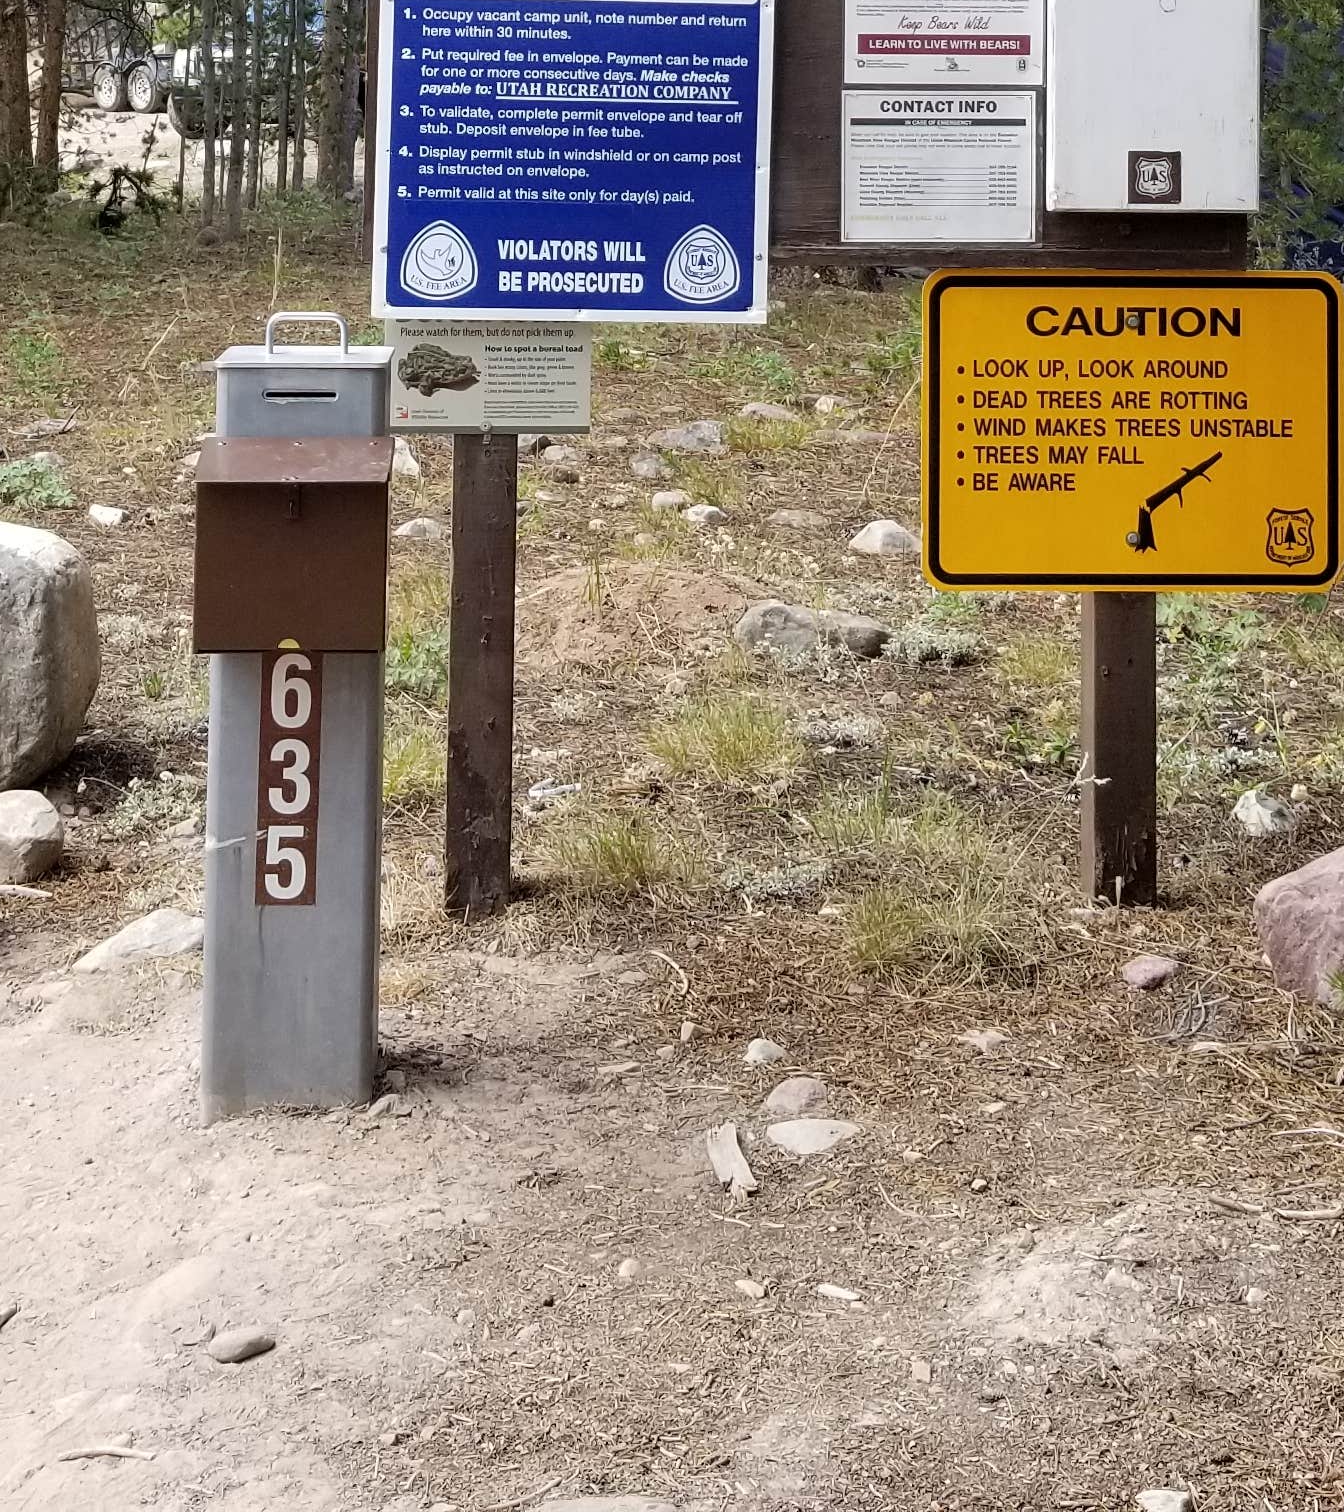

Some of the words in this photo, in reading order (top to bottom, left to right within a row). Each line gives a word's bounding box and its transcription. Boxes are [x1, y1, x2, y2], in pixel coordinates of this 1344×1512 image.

[404, 7, 417, 20] 1.
[423, 7, 473, 24] Occupy
[476, 9, 521, 22] vacant
[523, 12, 561, 26] camp
[564, 10, 590, 25] unit,
[595, 12, 625, 24] note
[628, 11, 677, 26] number
[680, 13, 706, 26] and
[708, 14, 747, 27] return
[897, 15, 922, 35] Keep
[927, 16, 958, 30] Bears
[964, 16, 991, 30] Wild
[422, 24, 451, 37] here
[454, 25, 494, 38] within
[497, 26, 513, 39] 30
[516, 26, 571, 40] minutes.
[869, 39, 907, 49] LEARN
[907, 40, 921, 49] TO
[924, 40, 947, 49] LIVE
[949, 40, 976, 49] WITH
[980, 40, 1020, 50] BEARS!
[401, 47, 416, 60] 2.
[422, 47, 444, 60] Put
[447, 48, 501, 64] required
[504, 49, 524, 62] fee
[527, 50, 539, 62] in
[542, 51, 603, 67] envelope.
[607, 52, 662, 67] Payment
[665, 54, 689, 65] can
[692, 53, 709, 66] be
[712, 54, 748, 67] made
[420, 65, 439, 78] for
[441, 68, 467, 78] one
[470, 69, 484, 79] or
[487, 69, 521, 80] more
[523, 68, 600, 81] consecutive
[603, 68, 636, 83] days.
[640, 69, 677, 82] Make
[681, 70, 730, 83] checks
[419, 82, 471, 97] payable
[475, 83, 492, 95] to:
[496, 81, 540, 97] UTAH
[546, 83, 649, 98] RECREATION
[653, 85, 732, 100] COMPANY
[400, 105, 414, 117] 3.
[420, 105, 436, 118] To
[439, 105, 494, 120] validate,
[497, 107, 559, 122] complete
[562, 108, 604, 123] permit
[607, 110, 666, 124] envelope
[669, 110, 693, 122] and
[696, 111, 723, 123] tear
[725, 111, 742, 123] off
[879, 100, 954, 113] CONTACT
[958, 100, 997, 113] INFO
[497, 239, 598, 261] VIOLATORS
[603, 240, 645, 262] WILL
[498, 271, 521, 292] BE
[527, 272, 644, 293] PROSECUTED
[1026, 306, 1241, 337] CAUTION
[400, 327, 424, 336] Please
[425, 327, 449, 337] watch
[450, 327, 461, 337] for
[462, 328, 484, 338] them,
[486, 328, 500, 337] but
[500, 328, 510, 337] do
[511, 328, 525, 337] not
[526, 328, 541, 339] pick
[542, 328, 562, 337] them
[973, 359, 1029, 378] LOOK
[1038, 359, 1070, 381] UP,
[1078, 360, 1134, 379] LOOK
[1143, 360, 1228, 379] AROUND
[973, 391, 1027, 409] DEAD
[1036, 391, 1102, 409] TREES
[1111, 391, 1150, 409] ARE
[1159, 392, 1248, 410] ROTTING
[973, 419, 1026, 437] WIND
[1035, 419, 1106, 437] MAKES
[1115, 419, 1181, 438] TREES
[1190, 419, 1293, 438] UNSTABLE
[973, 446, 1039, 464] TREES
[1048, 446, 1089, 465] MAY
[1097, 446, 1144, 465] FALL
[973, 473, 999, 491] BE
[1007, 473, 1076, 491] AWARE
[264, 652, 312, 901] 635
